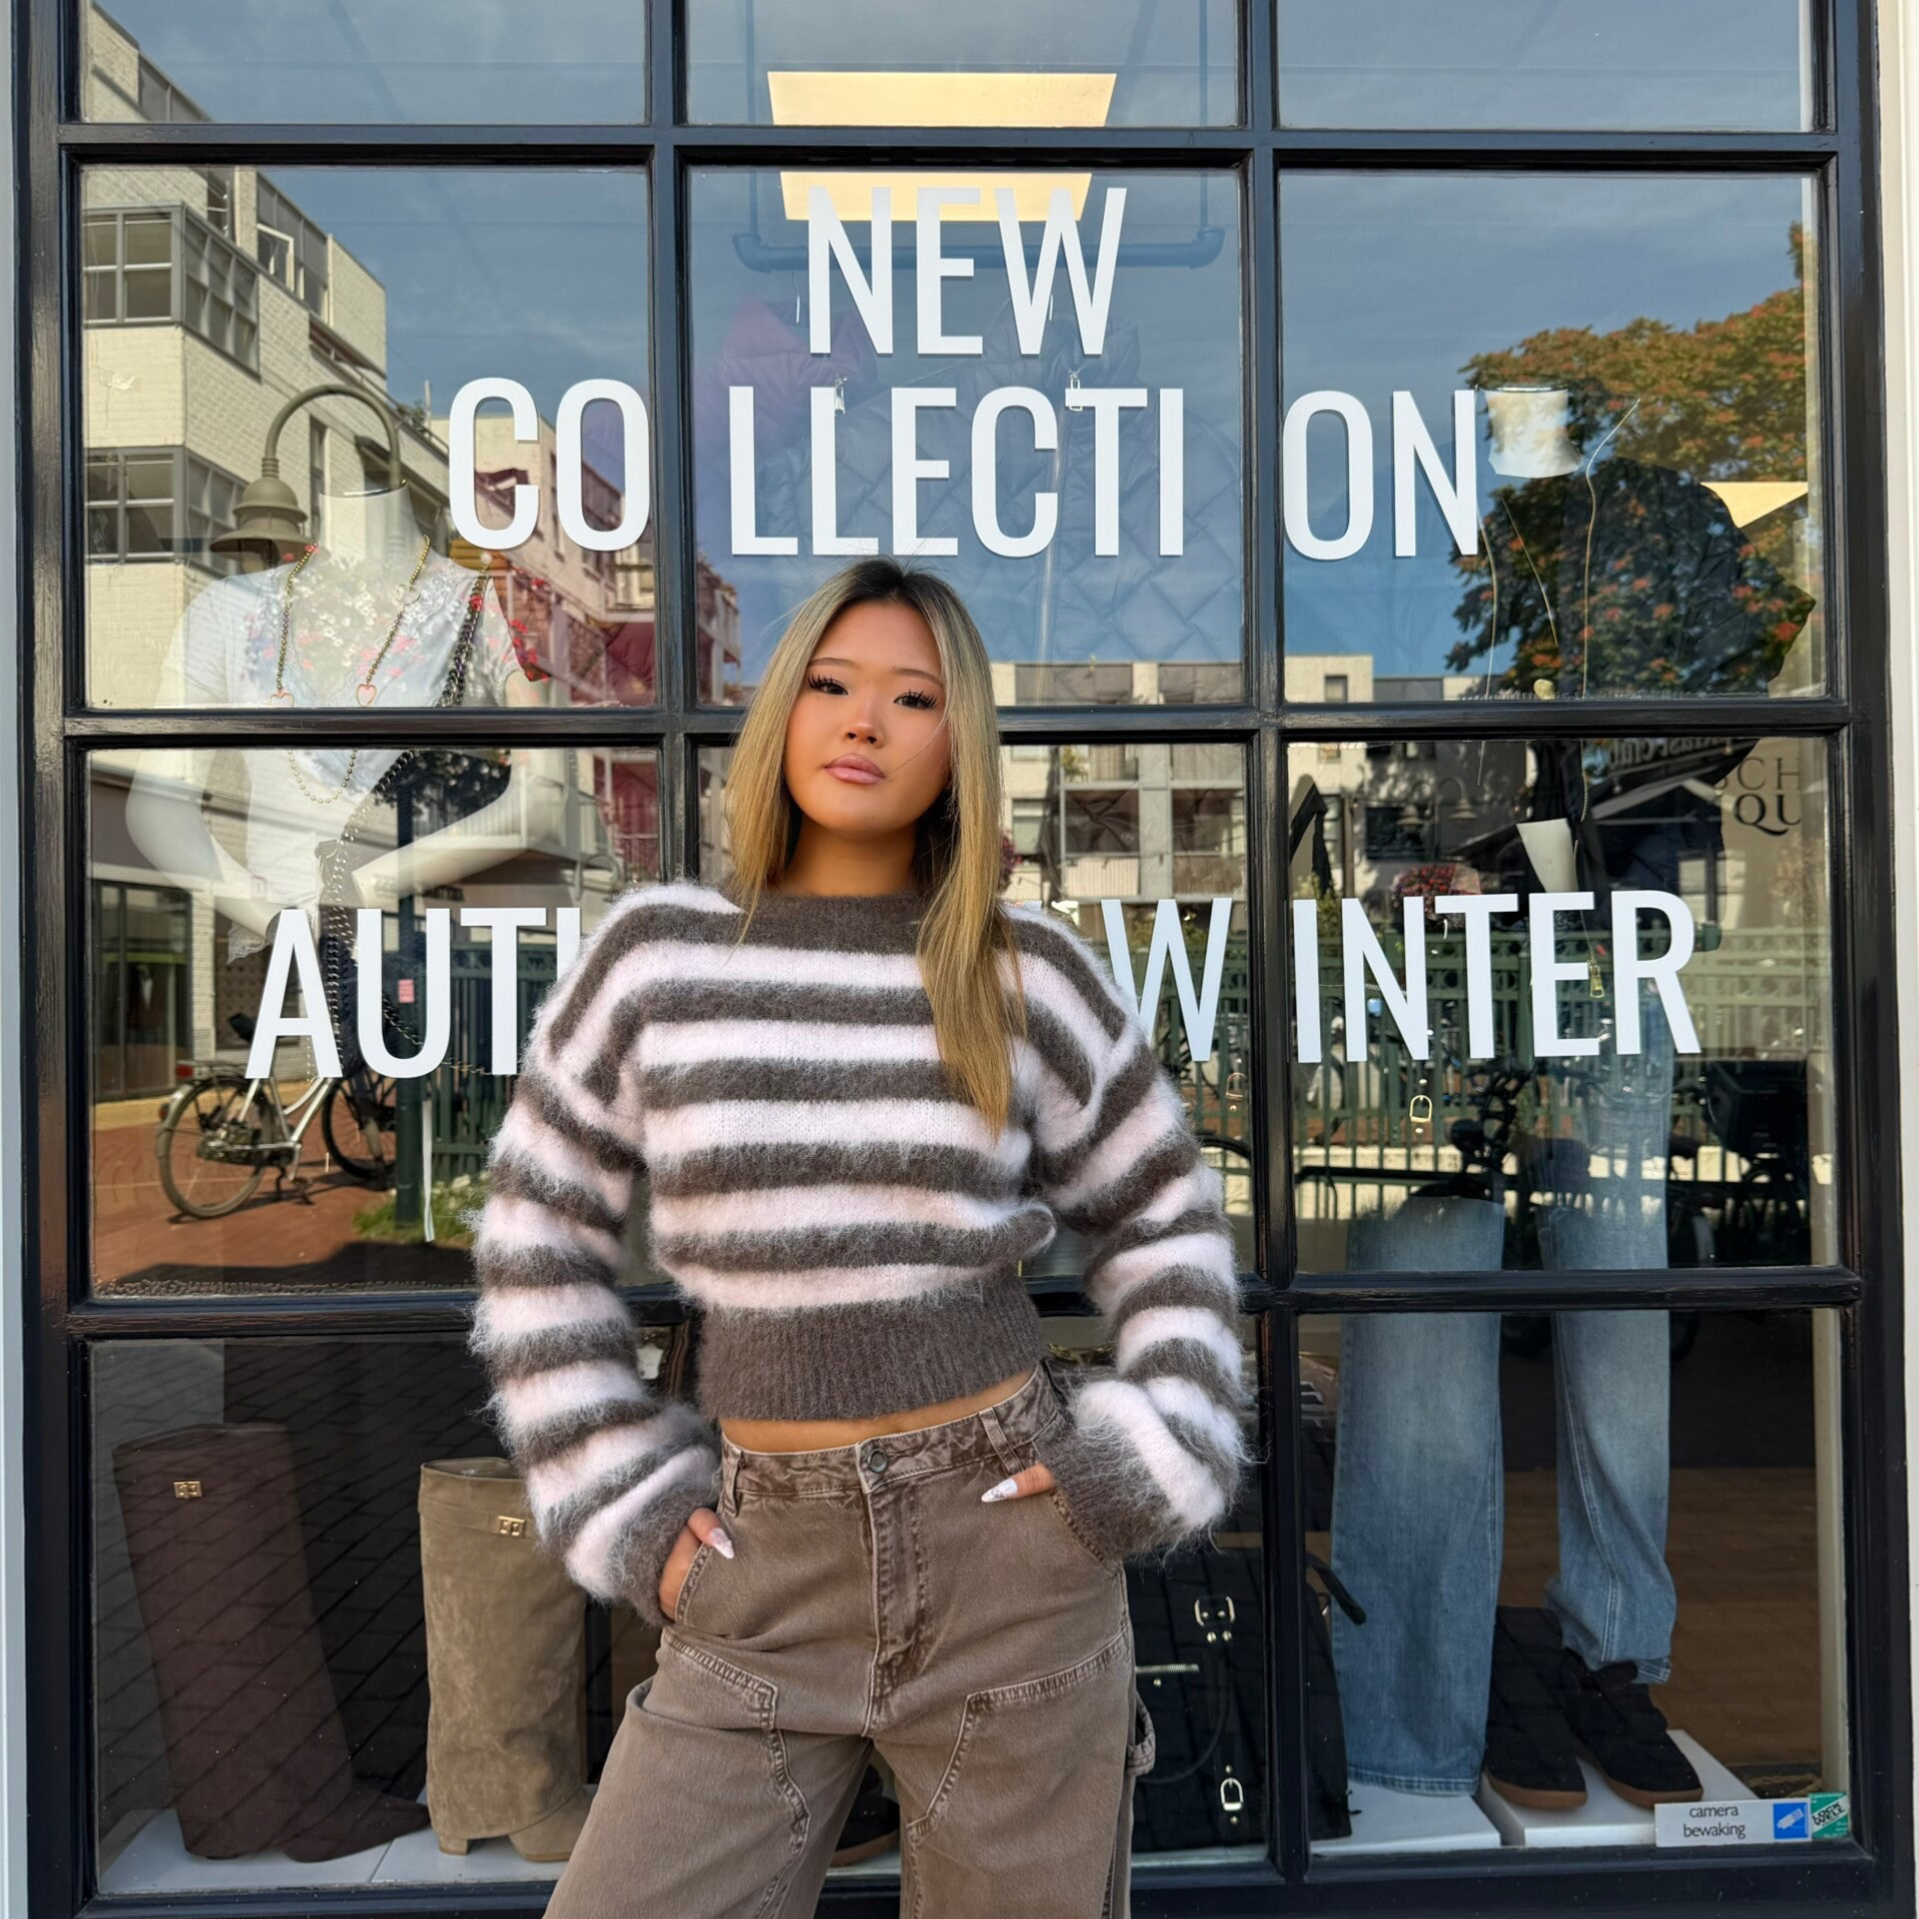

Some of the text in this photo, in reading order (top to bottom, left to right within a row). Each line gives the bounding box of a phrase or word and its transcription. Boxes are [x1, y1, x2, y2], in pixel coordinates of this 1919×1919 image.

[808, 186, 1127, 355] NEW
[448, 377, 1479, 560] COLLECTION
[1101, 890, 1701, 1063] WINTER
[1683, 1822, 1746, 1840] bewaking
[1689, 1805, 1739, 1818] camera
